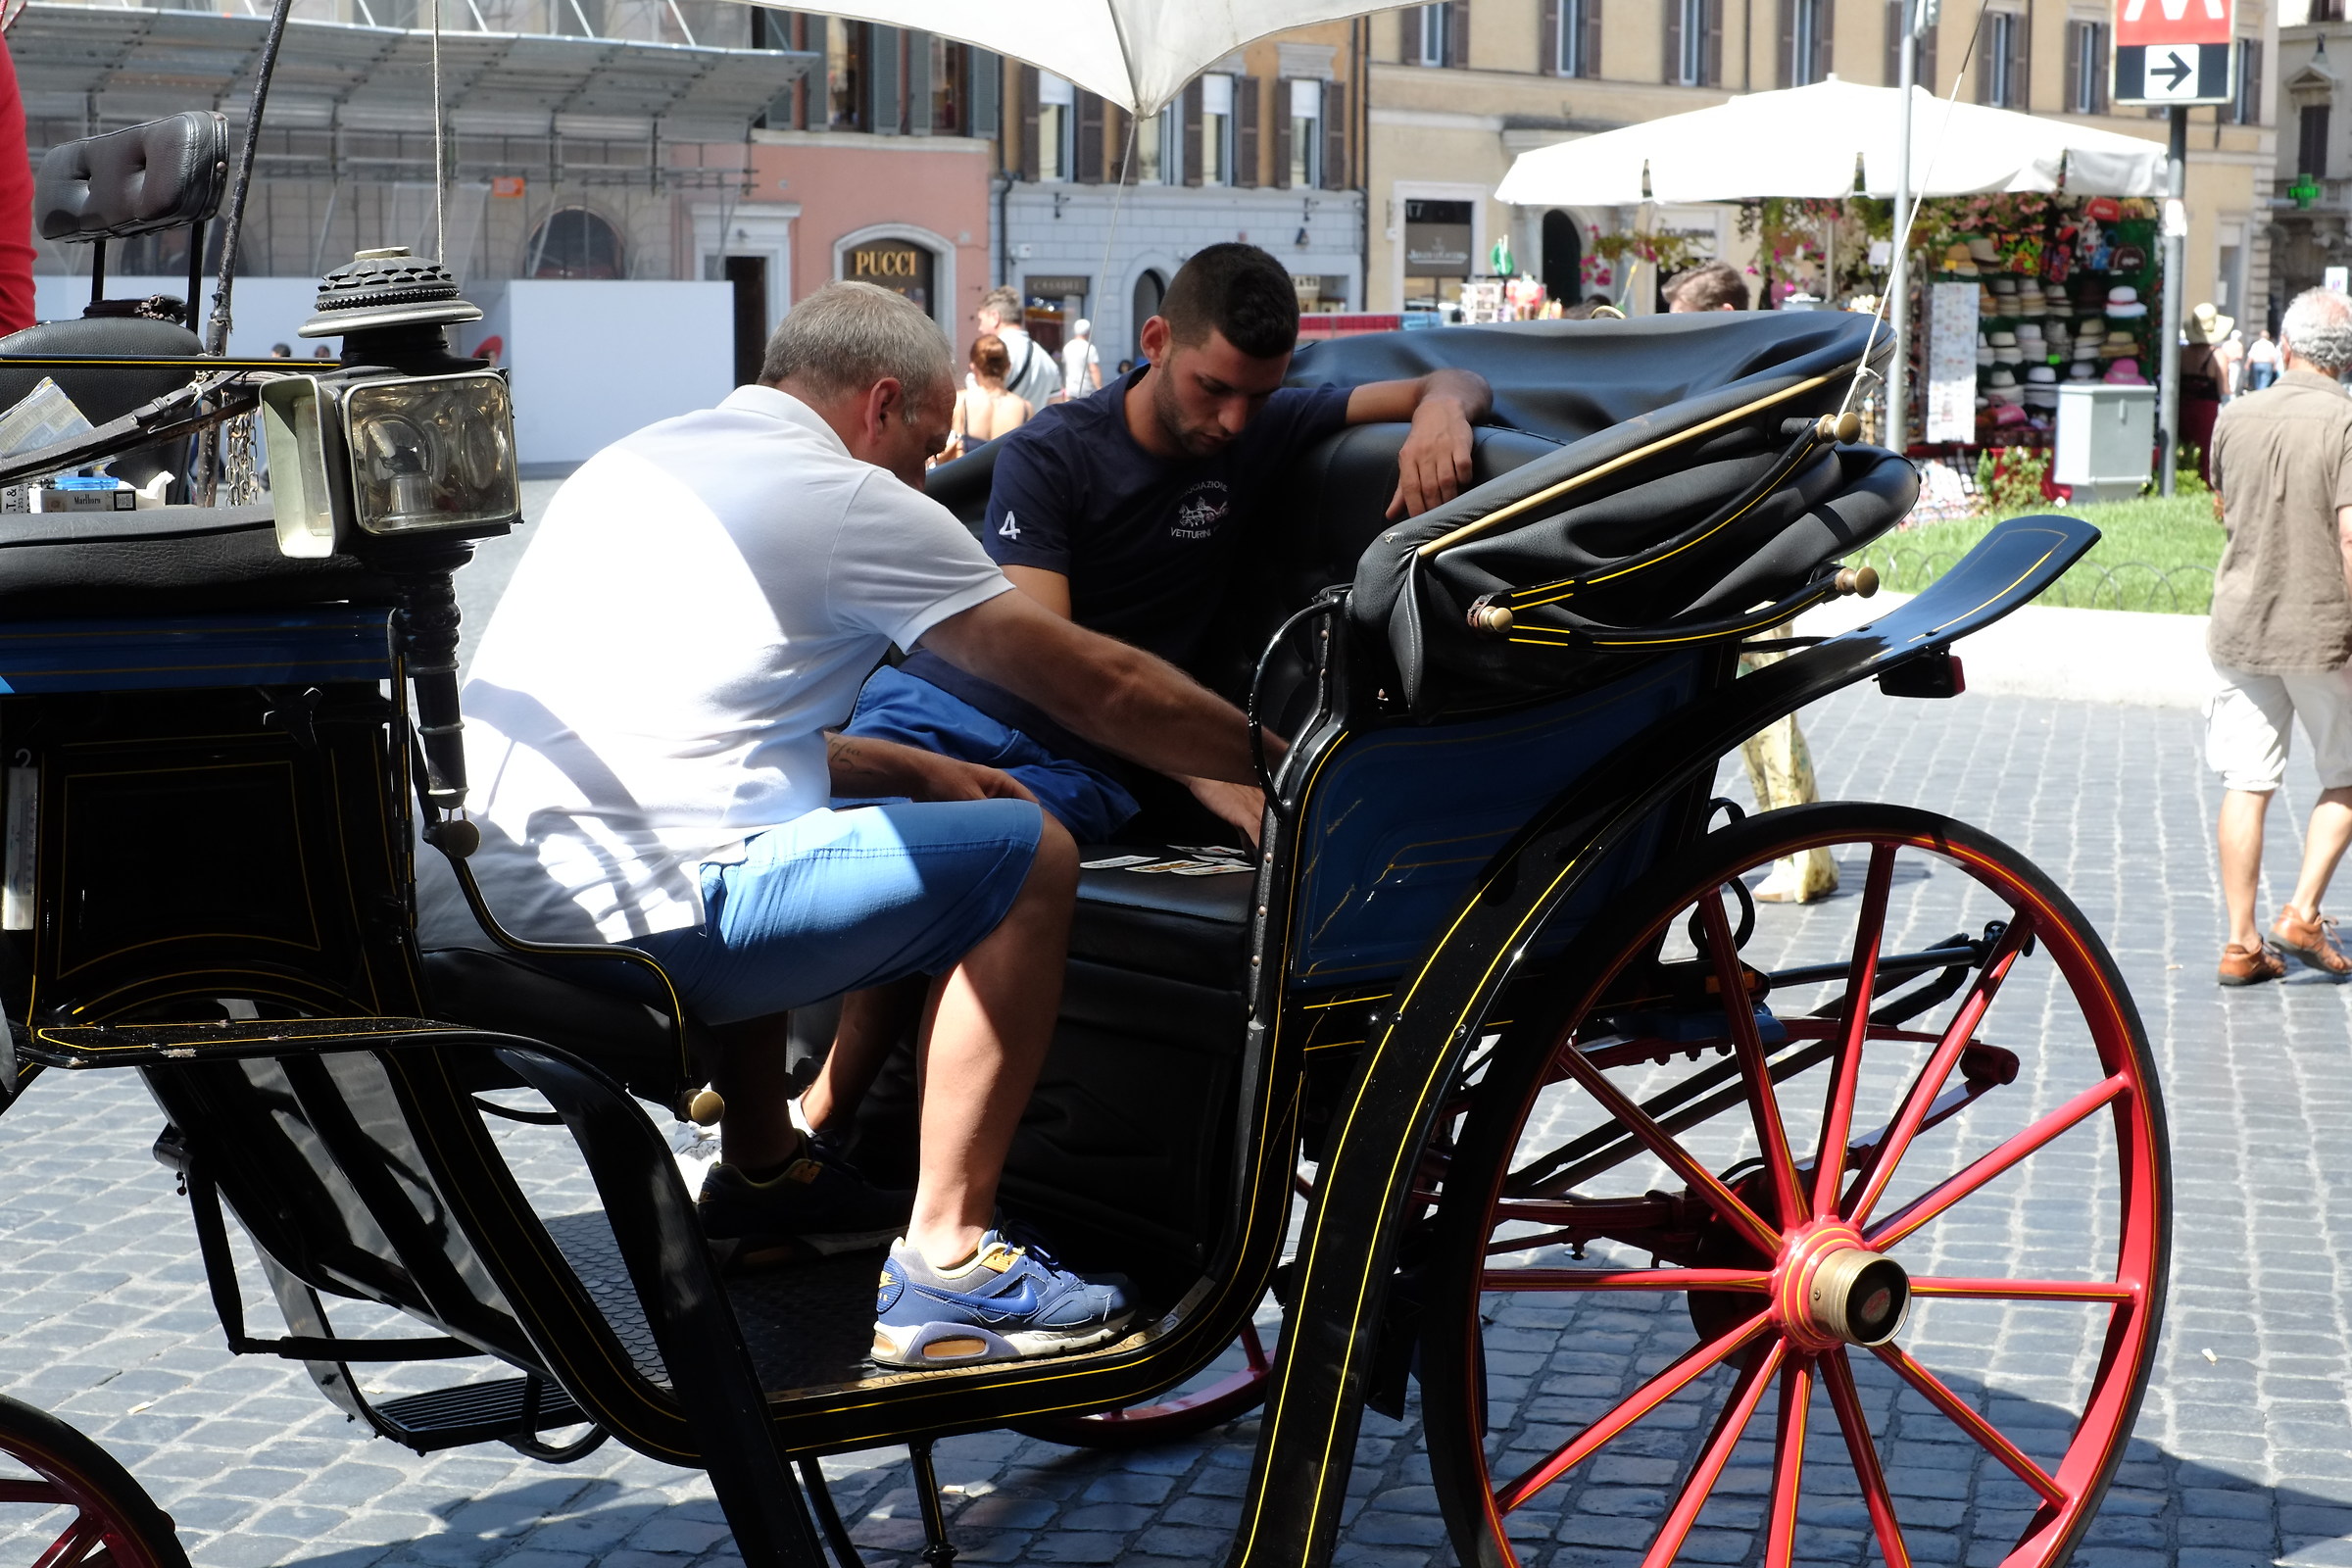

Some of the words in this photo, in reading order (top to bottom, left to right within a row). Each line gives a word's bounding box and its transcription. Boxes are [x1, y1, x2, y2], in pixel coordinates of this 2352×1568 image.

[856, 251, 916, 275] PUCCI
[74, 494, 101, 505] Marlboro
[999, 511, 1020, 540] 4
